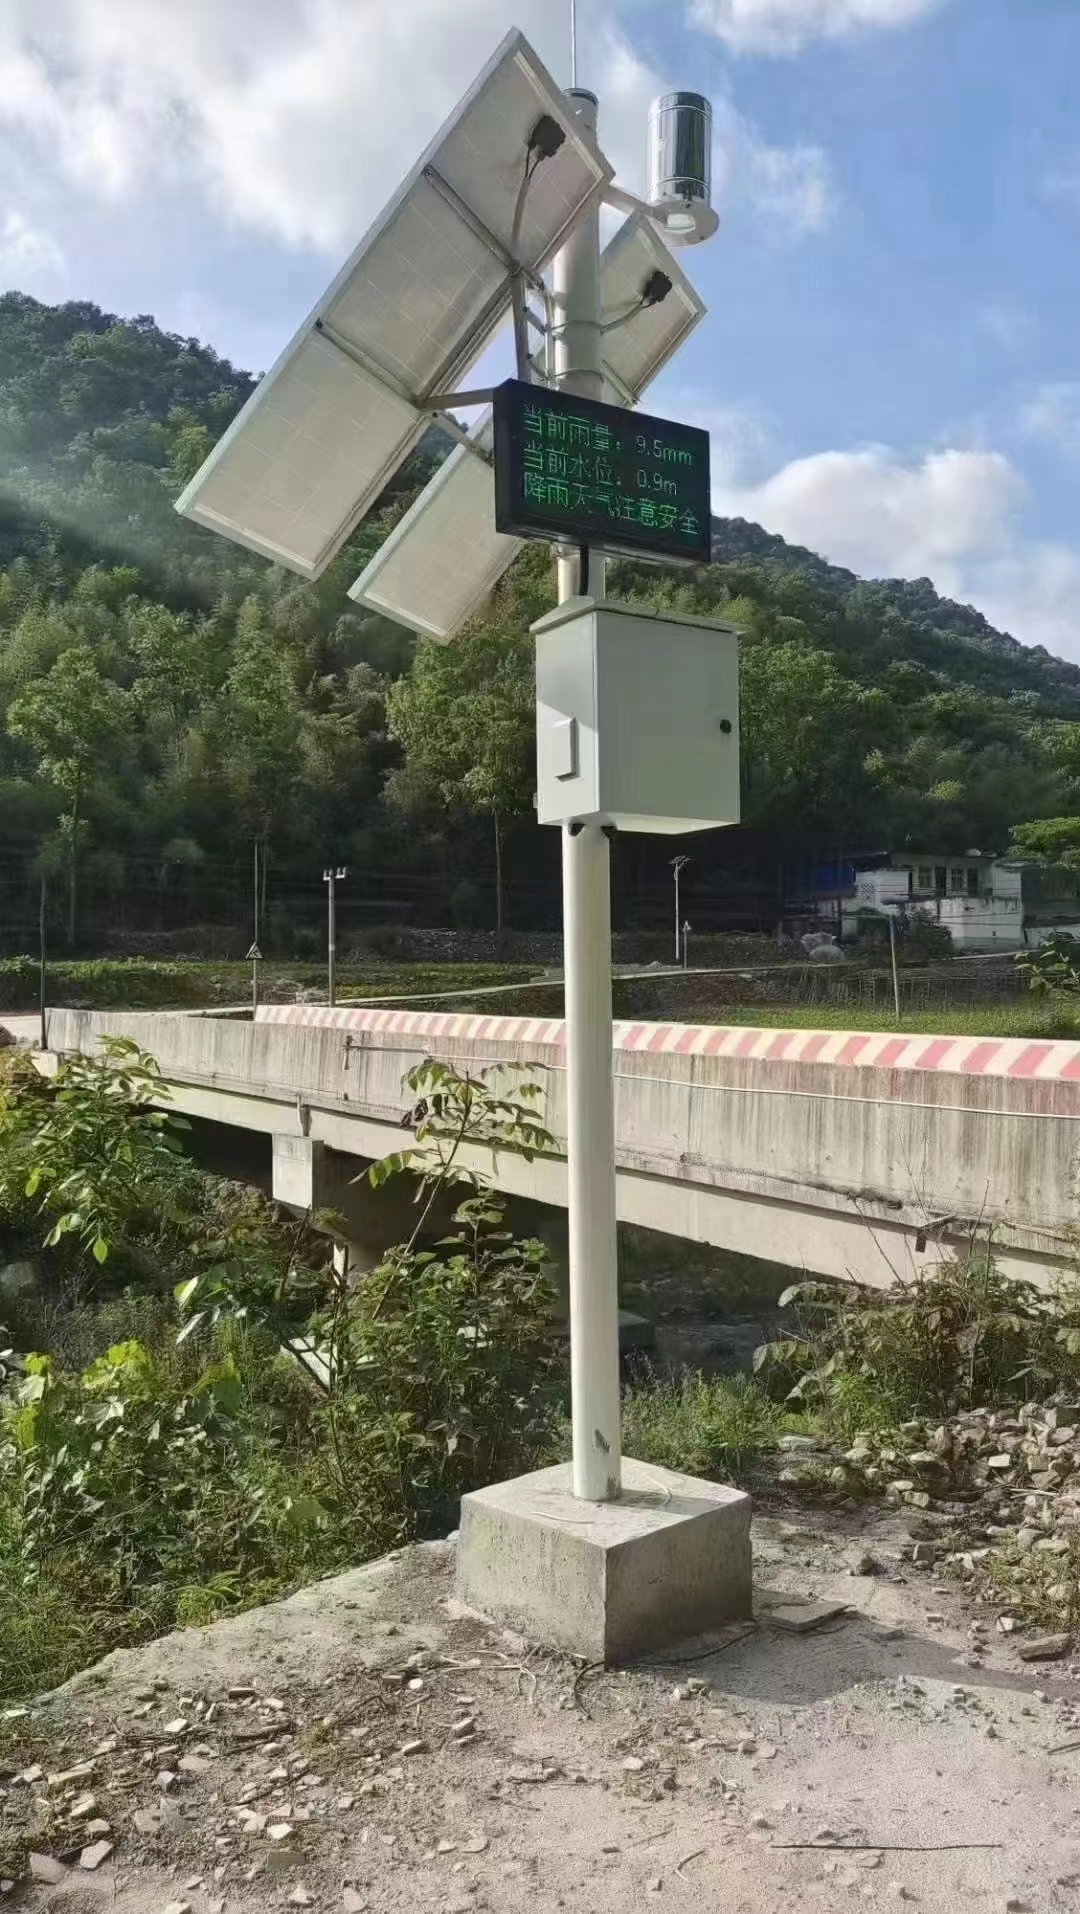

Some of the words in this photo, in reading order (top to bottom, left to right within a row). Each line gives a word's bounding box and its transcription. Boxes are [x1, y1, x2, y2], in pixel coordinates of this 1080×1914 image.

[524, 472, 700, 535] 降雨天气注意安全
